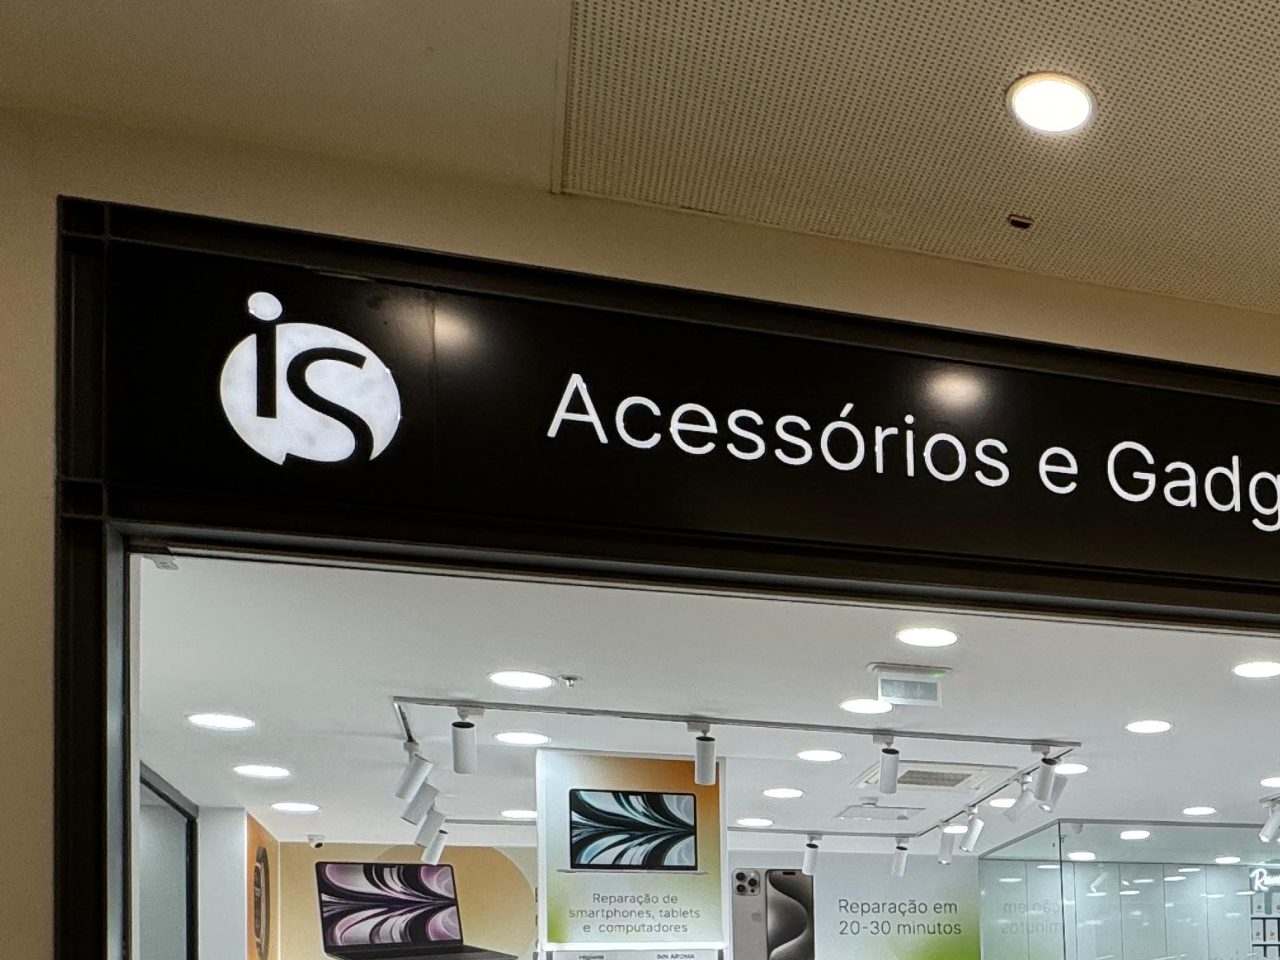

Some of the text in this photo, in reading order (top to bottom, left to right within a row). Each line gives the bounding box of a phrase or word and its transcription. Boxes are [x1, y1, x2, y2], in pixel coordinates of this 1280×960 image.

[546, 372, 1011, 488] Acessórios
[1038, 446, 1079, 495] e
[592, 893, 678, 906] Reparação de
[568, 908, 701, 920] smartphones, tablets
[838, 899, 959, 917] Reparação em
[582, 923, 688, 935] e computadores
[838, 920, 962, 935] 20-30 minutos
